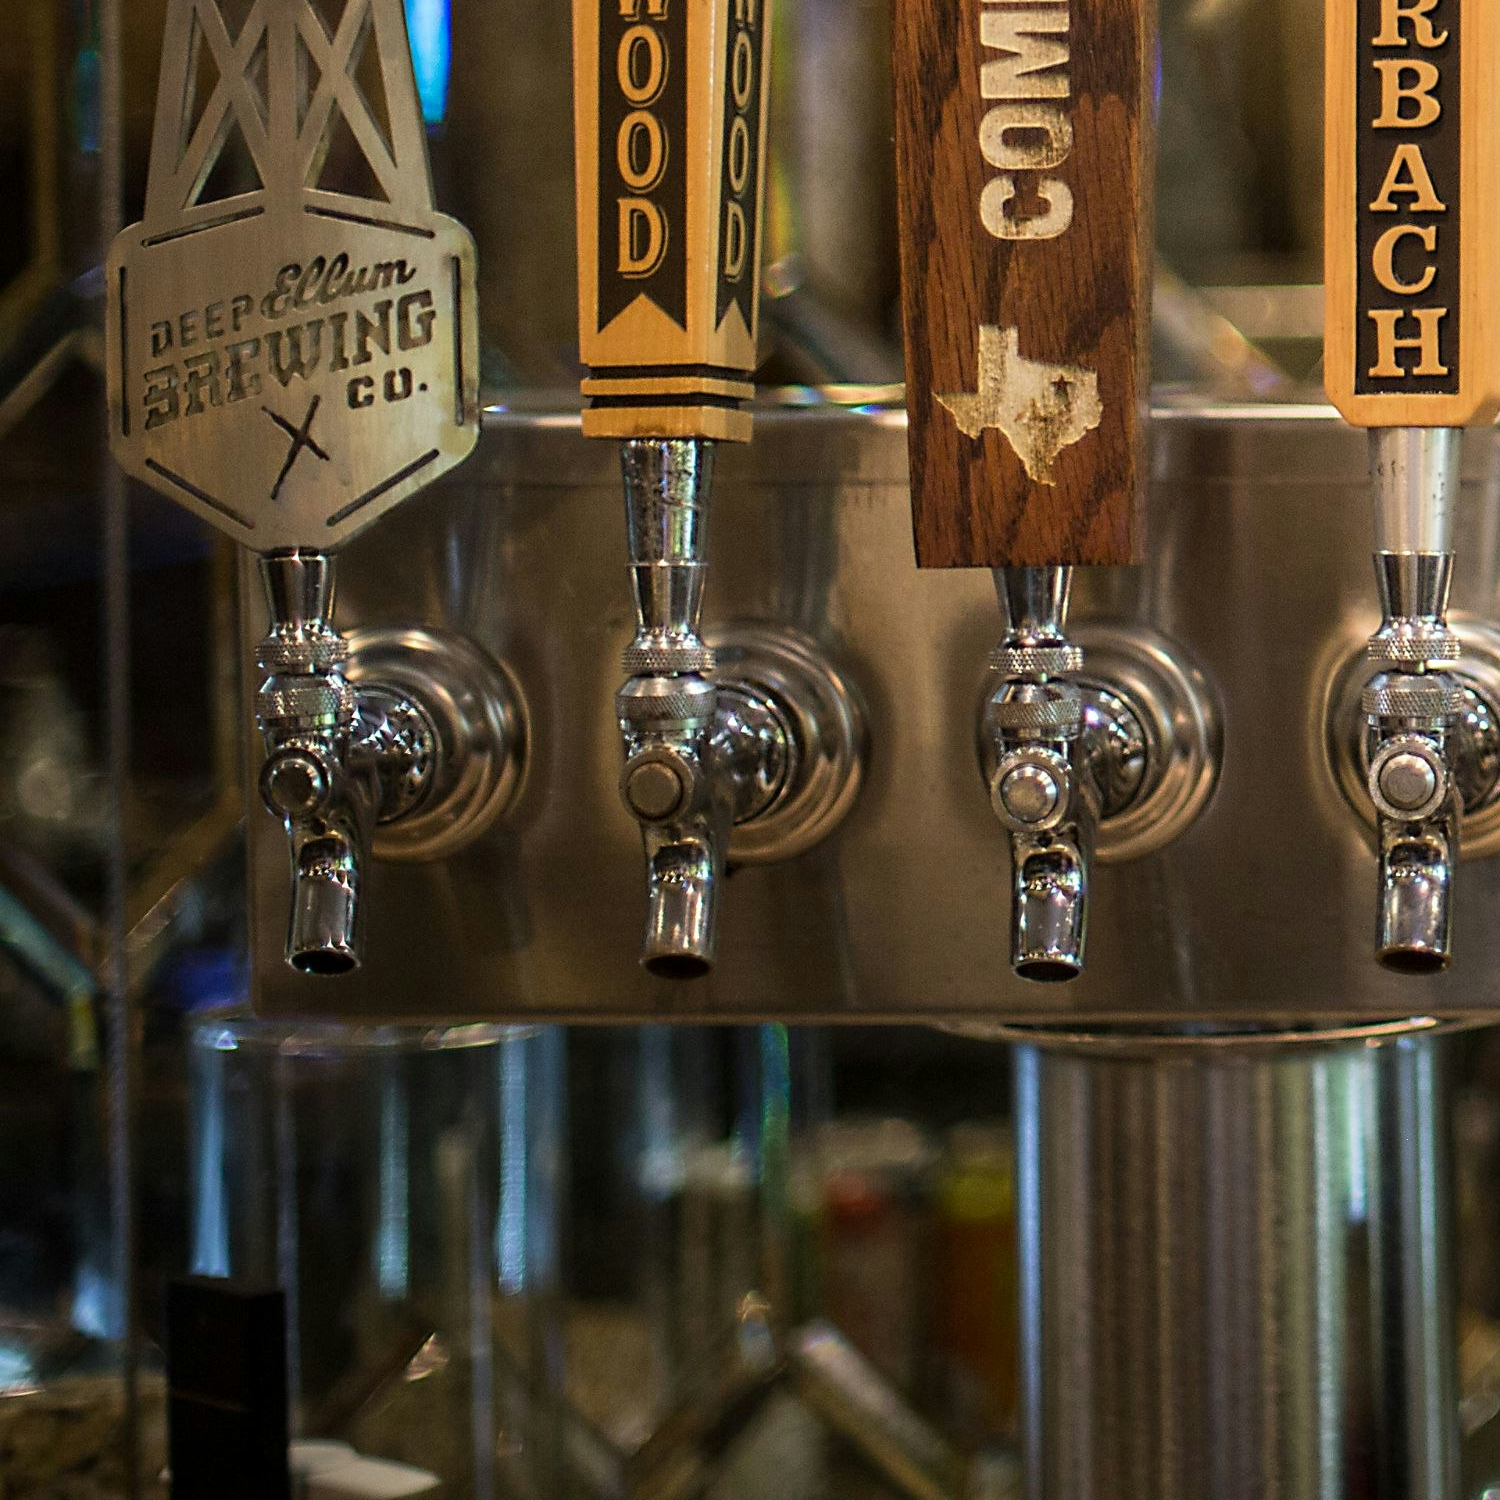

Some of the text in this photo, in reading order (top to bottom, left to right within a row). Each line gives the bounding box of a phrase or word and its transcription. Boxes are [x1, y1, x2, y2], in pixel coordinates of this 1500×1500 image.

[150, 251, 417, 359] DEEP Ellum
[143, 290, 438, 431] BREWING
[346, 366, 429, 411] CO.
